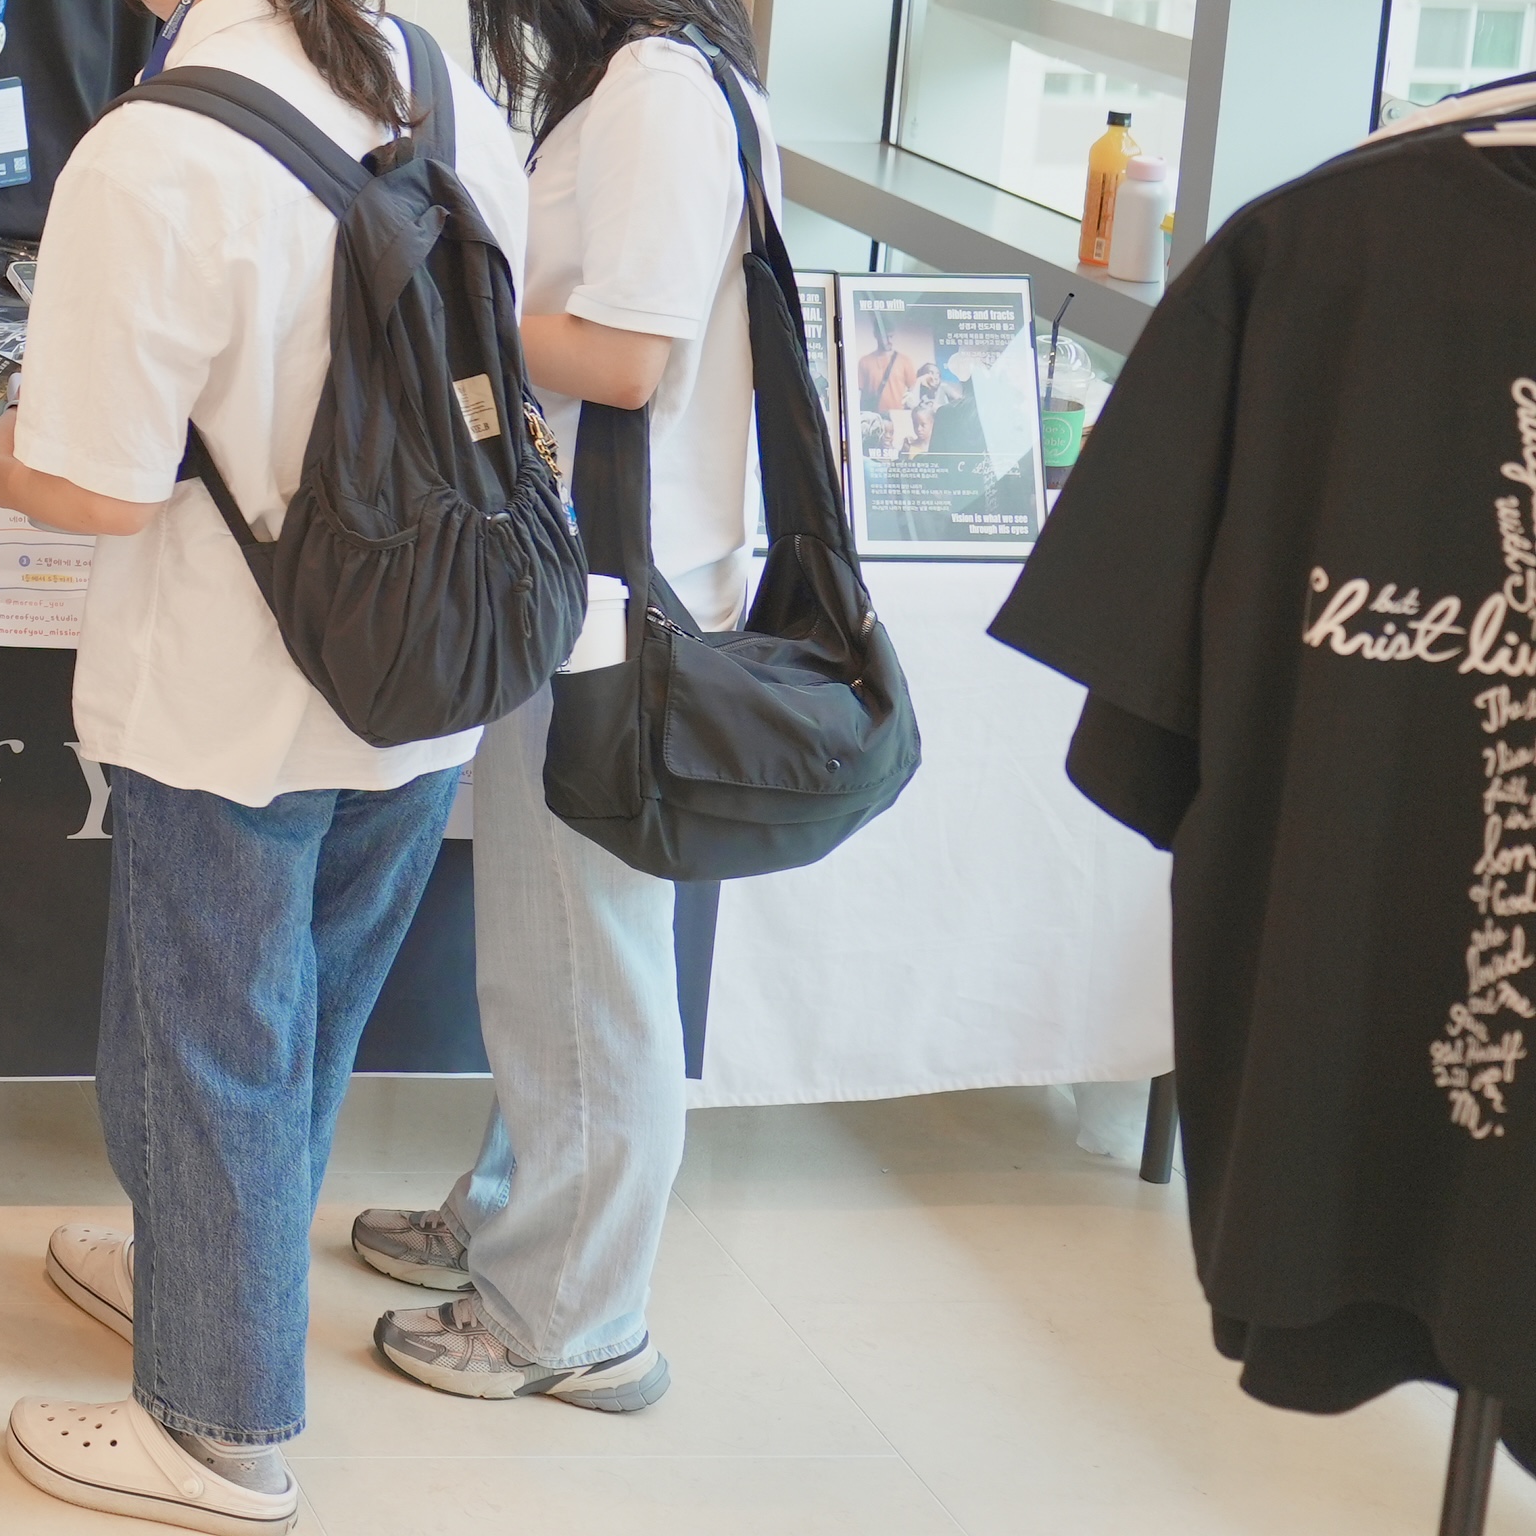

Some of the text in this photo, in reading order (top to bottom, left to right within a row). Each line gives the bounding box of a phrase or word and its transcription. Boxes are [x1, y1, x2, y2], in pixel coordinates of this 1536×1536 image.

[859, 299, 905, 311] we go with
[946, 308, 1015, 321] Bibles and tracts
[1044, 438, 1066, 446] able
[951, 513, 1028, 524] Vision is what we see
[969, 524, 1029, 536] through His eyes
[36, 557, 72, 568] 스탭에게
[5, 598, 65, 609] @moreof_you
[1368, 583, 1420, 615] but
